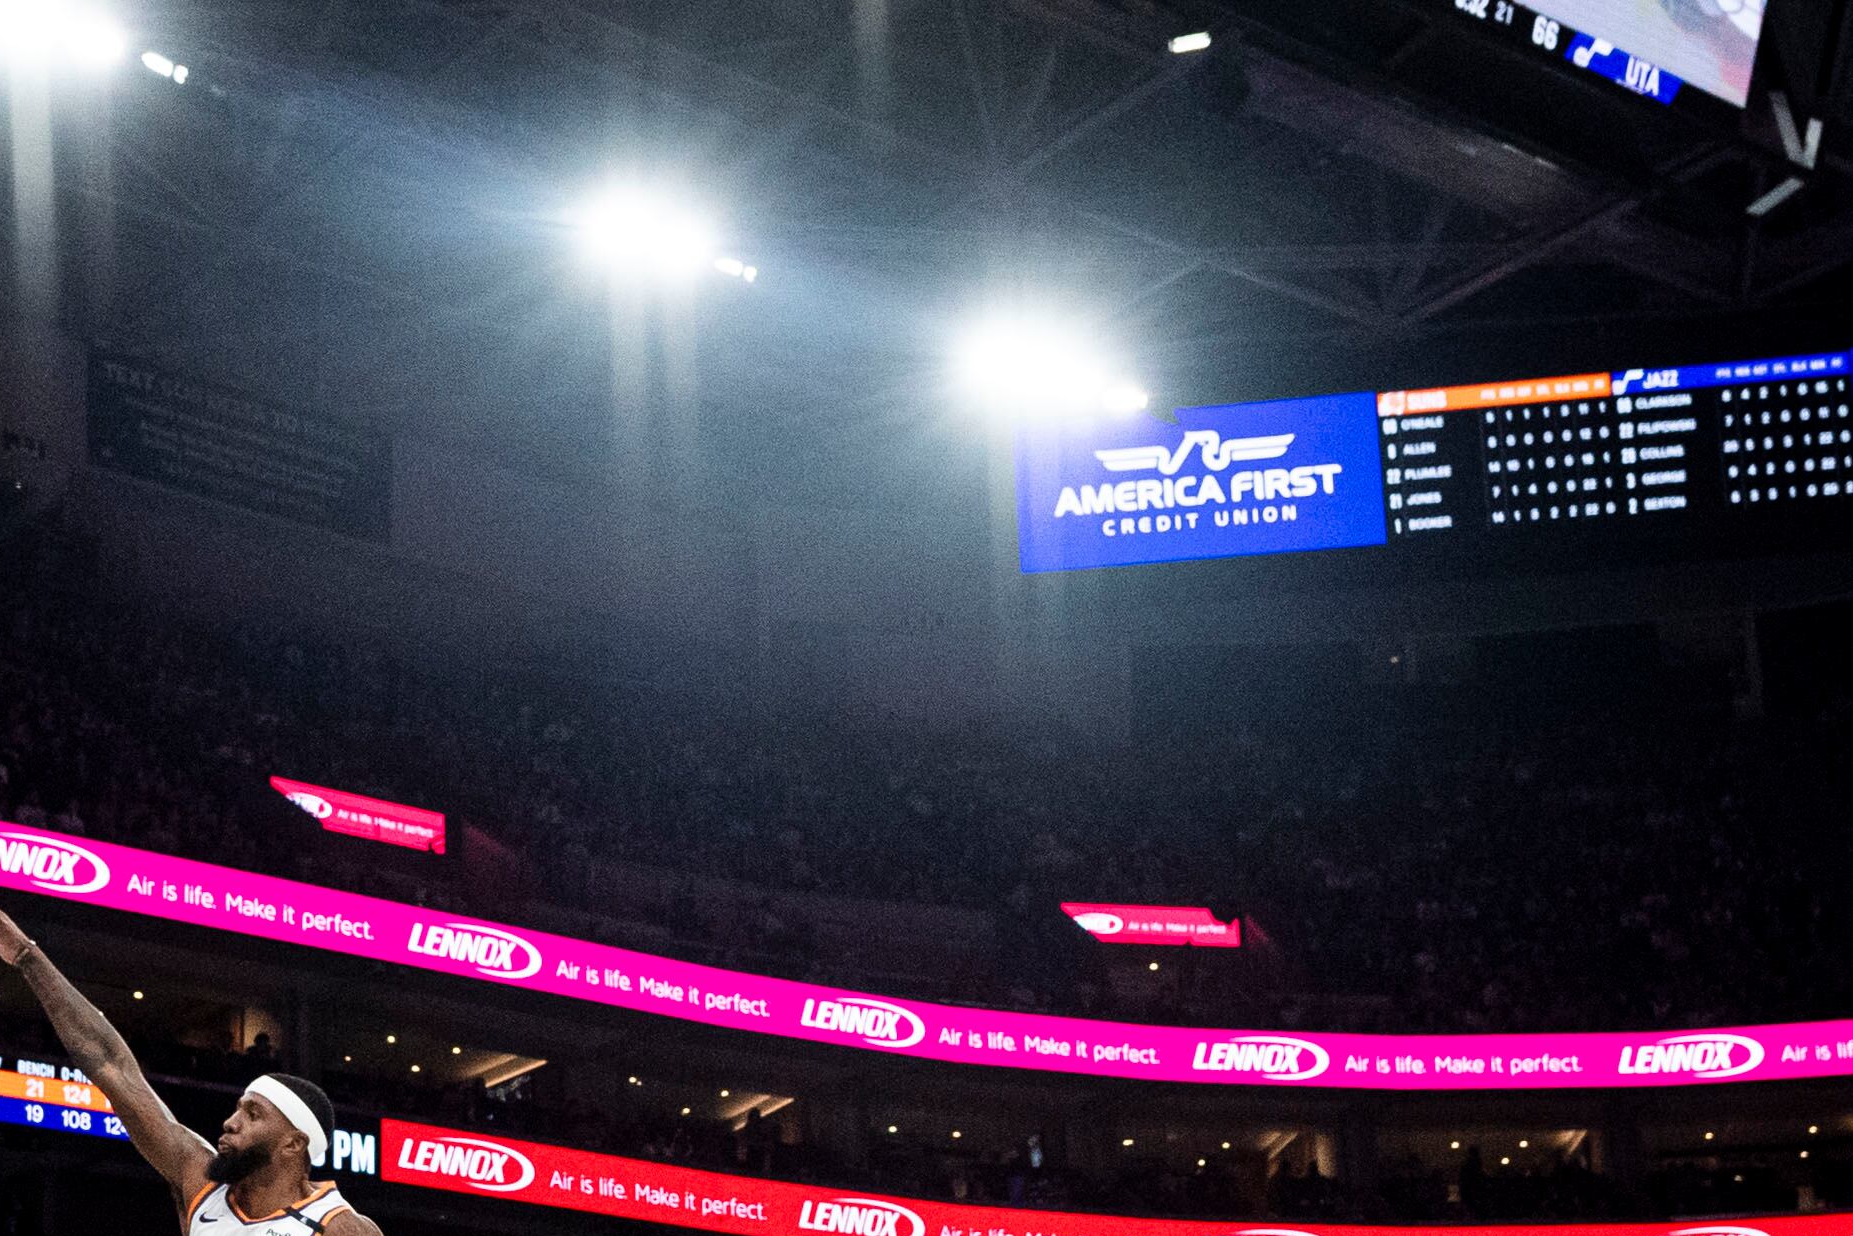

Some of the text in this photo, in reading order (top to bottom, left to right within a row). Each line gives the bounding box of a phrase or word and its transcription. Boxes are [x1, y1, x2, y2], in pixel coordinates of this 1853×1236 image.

[1495, 5, 1514, 25] 21
[1532, 15, 1560, 50] 66
[1625, 56, 1661, 97] UTA
[1644, 370, 1679, 388] JAZZ
[1054, 463, 1343, 518] AMERICA FIRST
[1102, 504, 1298, 537] CREDIT UNION
[127, 872, 155, 897] Air
[162, 879, 177, 902] is
[184, 883, 217, 909] life.
[225, 892, 277, 924] Make
[283, 902, 297, 924] it
[302, 909, 375, 942] perfect.
[408, 922, 519, 972] LENNOX
[556, 960, 581, 981] Air
[586, 964, 600, 986] is
[605, 967, 633, 992] life.
[640, 975, 684, 1003] Make
[689, 983, 700, 1005] it
[705, 987, 770, 1018] perfect.
[801, 998, 902, 1040] LENNOX
[939, 1026, 963, 1046] Air
[968, 1027, 983, 1048] is
[988, 1029, 1018, 1052] life.
[1025, 1034, 1072, 1058] Make
[1076, 1038, 1088, 1059] it
[1094, 1041, 1160, 1066] perfect.
[1192, 1042, 1304, 1074] LENNOX
[1345, 1053, 1369, 1073] Air
[1376, 1054, 1390, 1074] is
[1395, 1054, 1427, 1075] life.
[1434, 1054, 1486, 1075] Make
[1491, 1054, 1503, 1075] it
[1510, 1053, 1584, 1077] perfect.
[1618, 1040, 1736, 1075] LENNOX
[16, 1059, 55, 1079] BENCH
[26, 1079, 44, 1098] 21
[62, 1085, 92, 1106] 124
[25, 1104, 44, 1123] 19
[61, 1110, 92, 1131] 108
[333, 1129, 375, 1175] PM
[399, 1137, 508, 1184] LENNOX
[549, 1170, 574, 1193] Air
[580, 1173, 594, 1196] is
[599, 1176, 629, 1200] life.
[634, 1184, 680, 1210] Make
[684, 1190, 697, 1212] it
[702, 1193, 767, 1221] perfect.
